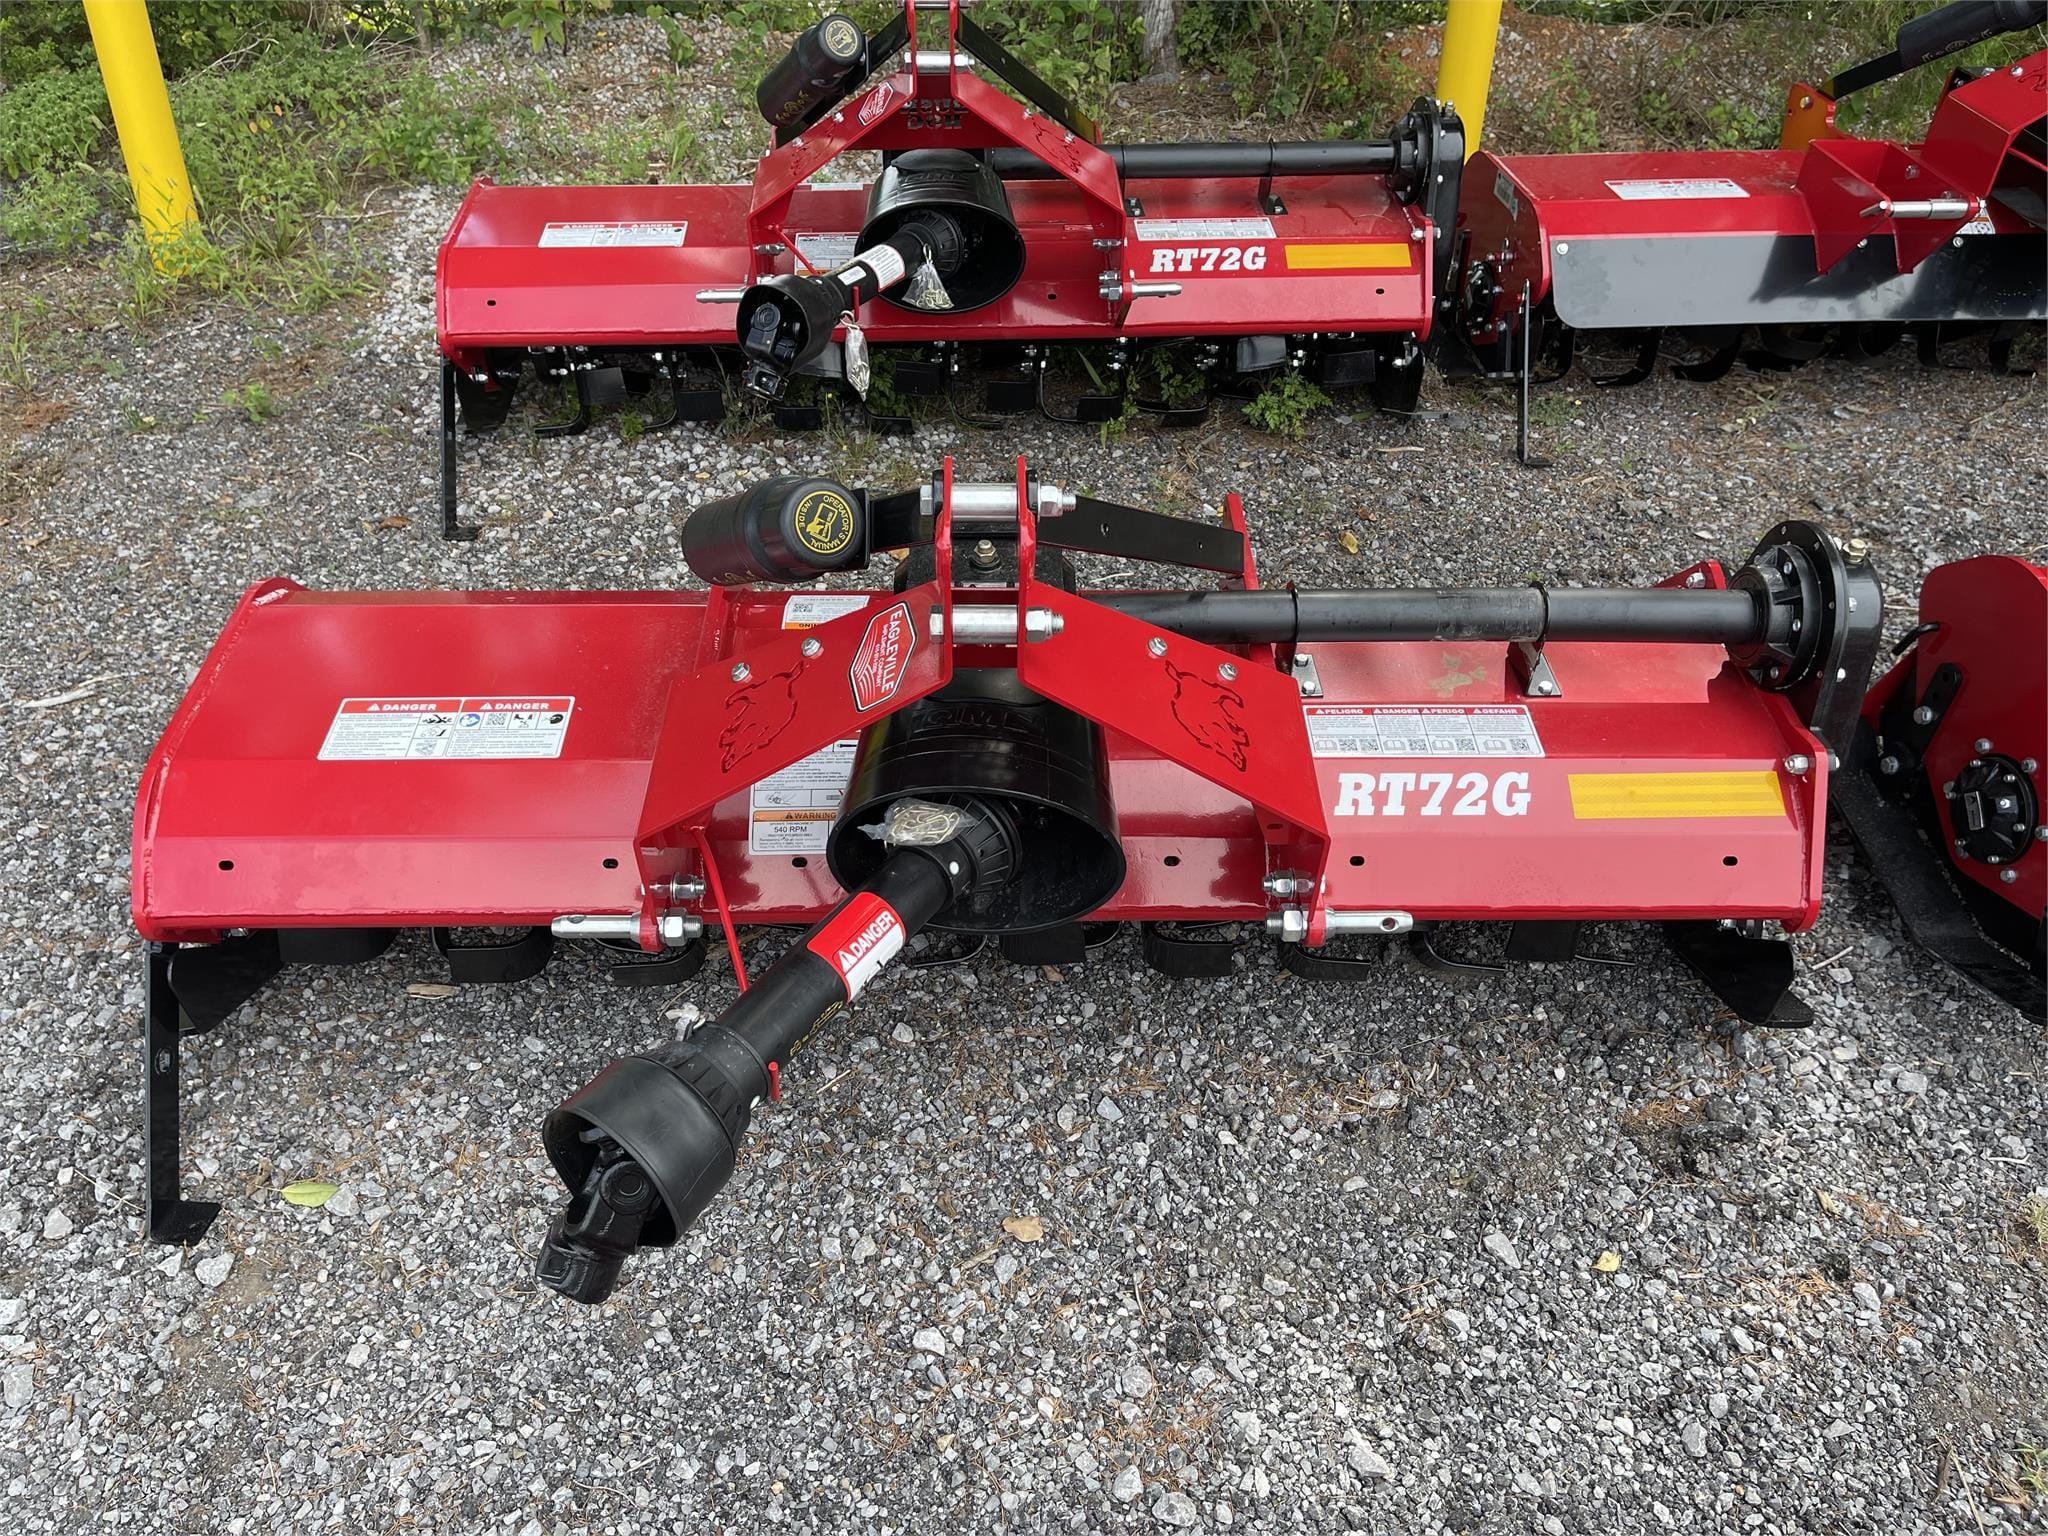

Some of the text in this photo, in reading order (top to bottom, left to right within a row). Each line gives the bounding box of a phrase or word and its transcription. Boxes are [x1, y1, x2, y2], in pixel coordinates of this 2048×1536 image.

[1149, 246, 1267, 272] RT72G
[799, 495, 849, 550] OPERATOR'S MANUAL INSIDE
[881, 609, 903, 693] EAGLEVILLE
[381, 703, 437, 711] DANGER
[494, 702, 550, 710] DANGER
[1333, 771, 1532, 816] RT72G
[849, 910, 896, 959] DANGER
